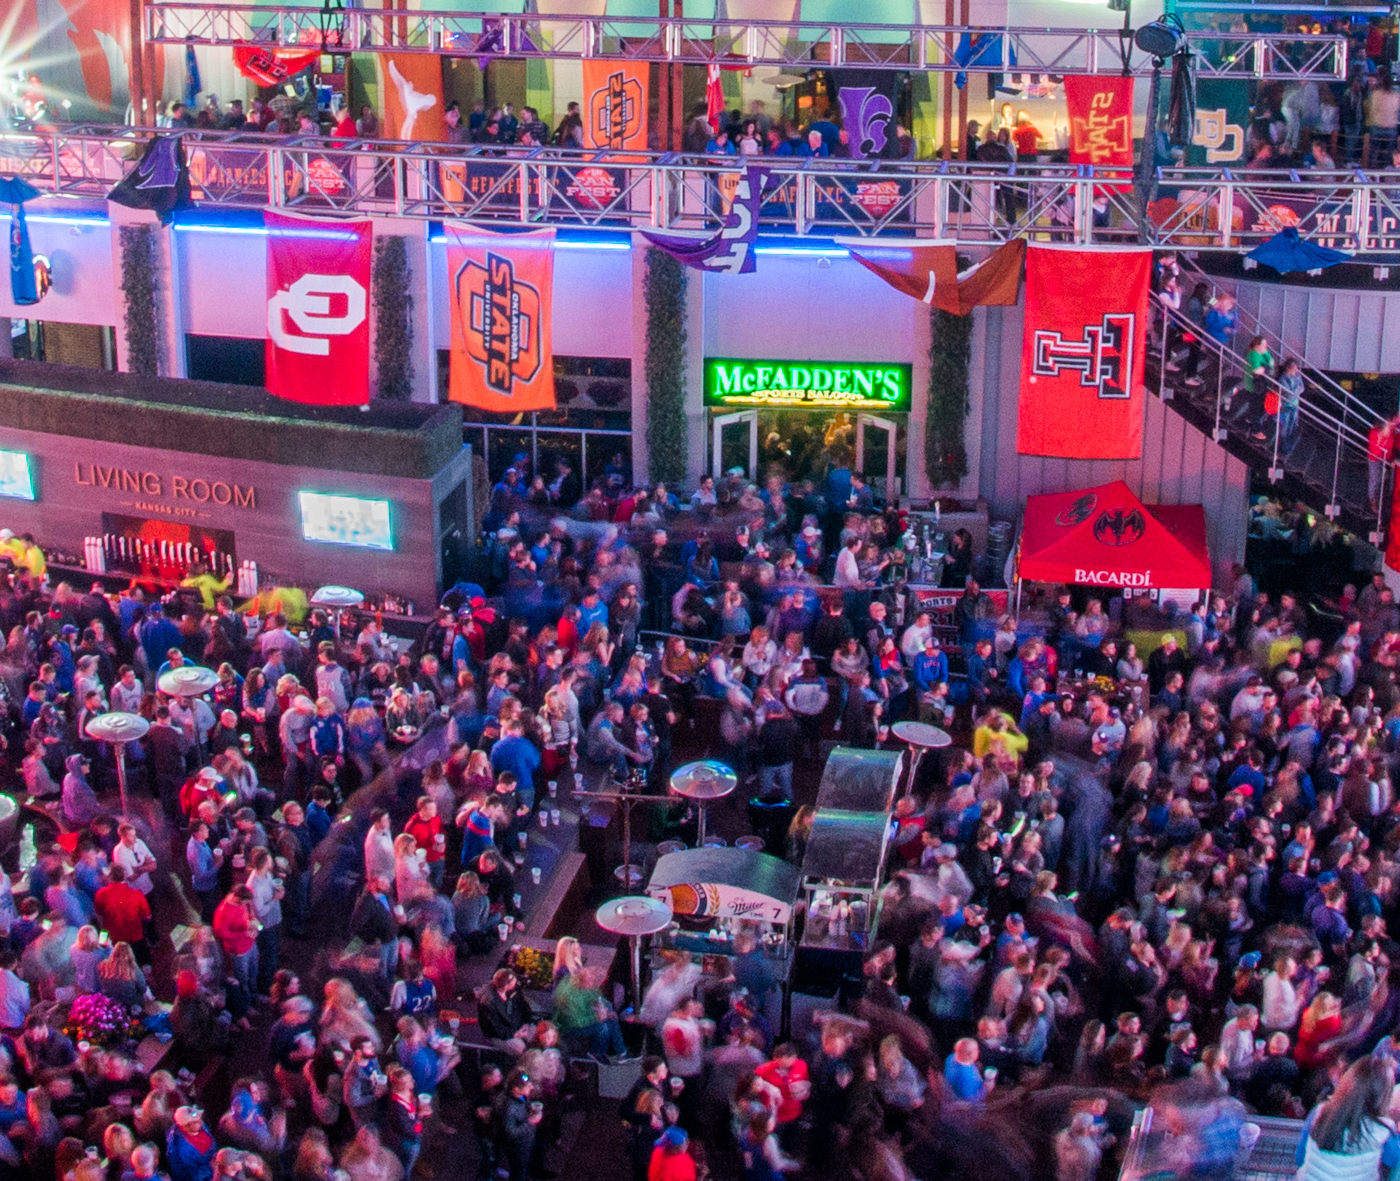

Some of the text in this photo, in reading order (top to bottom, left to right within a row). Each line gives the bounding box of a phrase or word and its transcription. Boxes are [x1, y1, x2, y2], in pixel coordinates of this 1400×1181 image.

[571, 176, 616, 187] FAN
[565, 186, 621, 198] FEST
[488, 256, 514, 394] STATE
[714, 365, 901, 401] McFADDEN'S
[74, 461, 256, 509] LIVING ROOM
[135, 501, 197, 518] KANSAS CITY
[1074, 568, 1152, 587] BACARDÍ
[772, 907, 782, 920] 7
